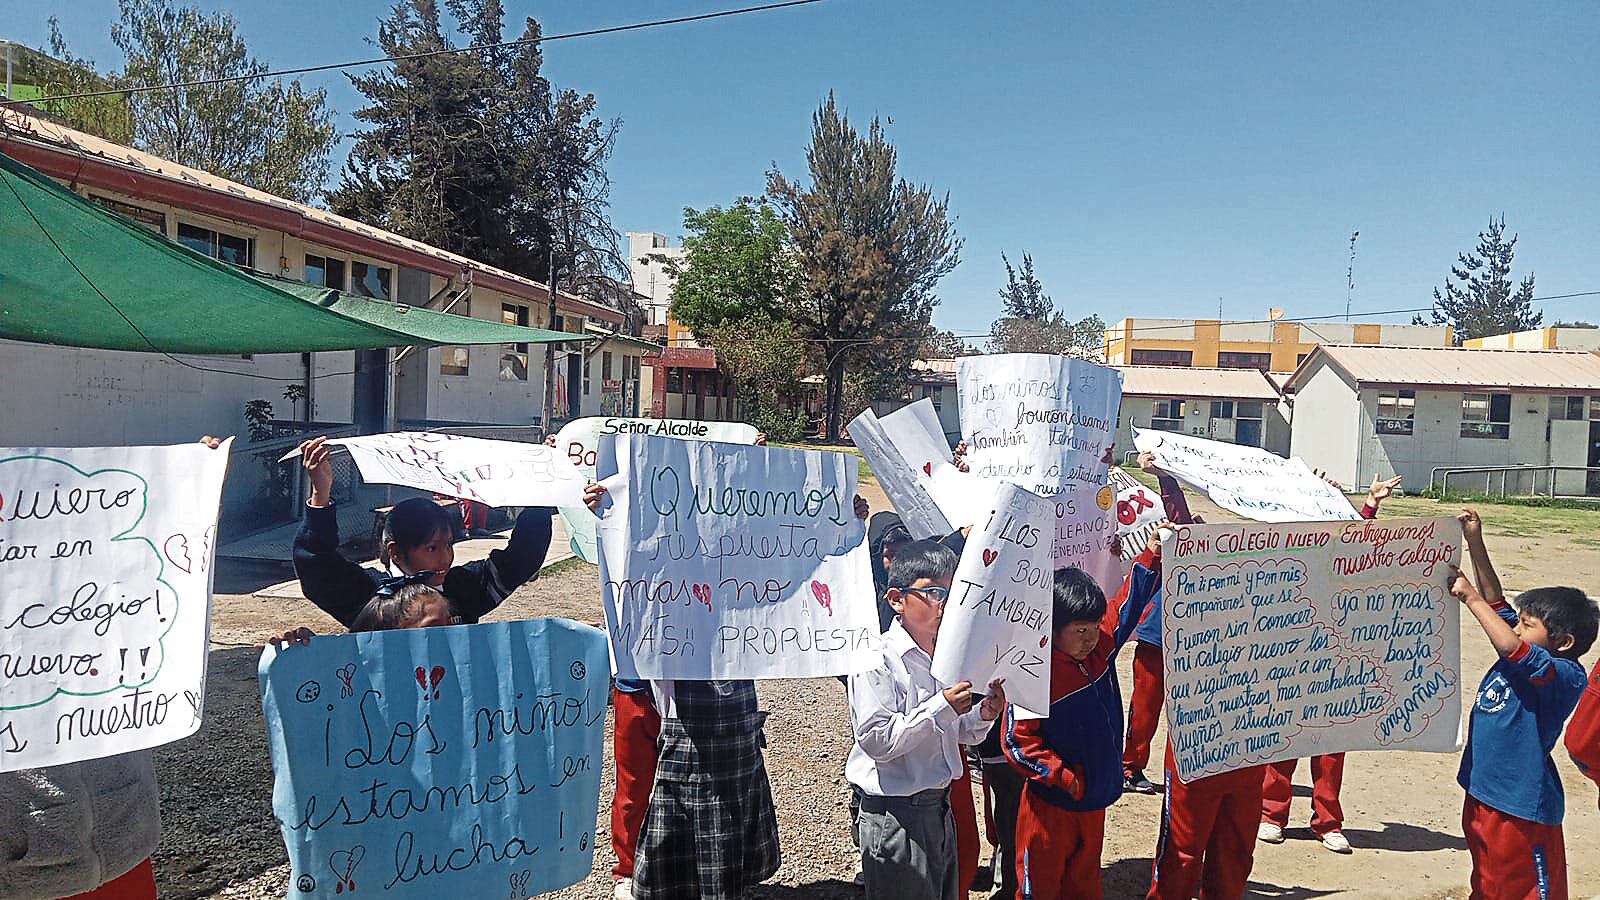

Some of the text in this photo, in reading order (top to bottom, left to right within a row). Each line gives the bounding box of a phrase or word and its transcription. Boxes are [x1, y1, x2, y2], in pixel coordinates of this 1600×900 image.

[1002, 377, 1062, 401] niños
[604, 417, 652, 435] Señor
[0, 484, 137, 522] uiero
[651, 465, 848, 531] Queremos
[50, 540, 92, 559] en
[649, 523, 828, 581] respuesta
[1285, 531, 1330, 548] NUEVO
[719, 578, 792, 604] no
[1245, 572, 1254, 595] y
[1280, 566, 1300, 582] mis
[960, 579, 1050, 632] TAMBIEN
[1337, 593, 1359, 627] ya
[1366, 592, 1385, 611] no
[1351, 610, 1433, 643] mentiras
[993, 643, 1045, 679] VOZ
[1174, 651, 1191, 672] mi
[1248, 638, 1304, 661] nuevo
[1403, 659, 1423, 682] de
[56, 687, 178, 744] nuestro
[472, 687, 602, 748] niños
[1301, 705, 1318, 720] en
[290, 754, 591, 831] estamos en
